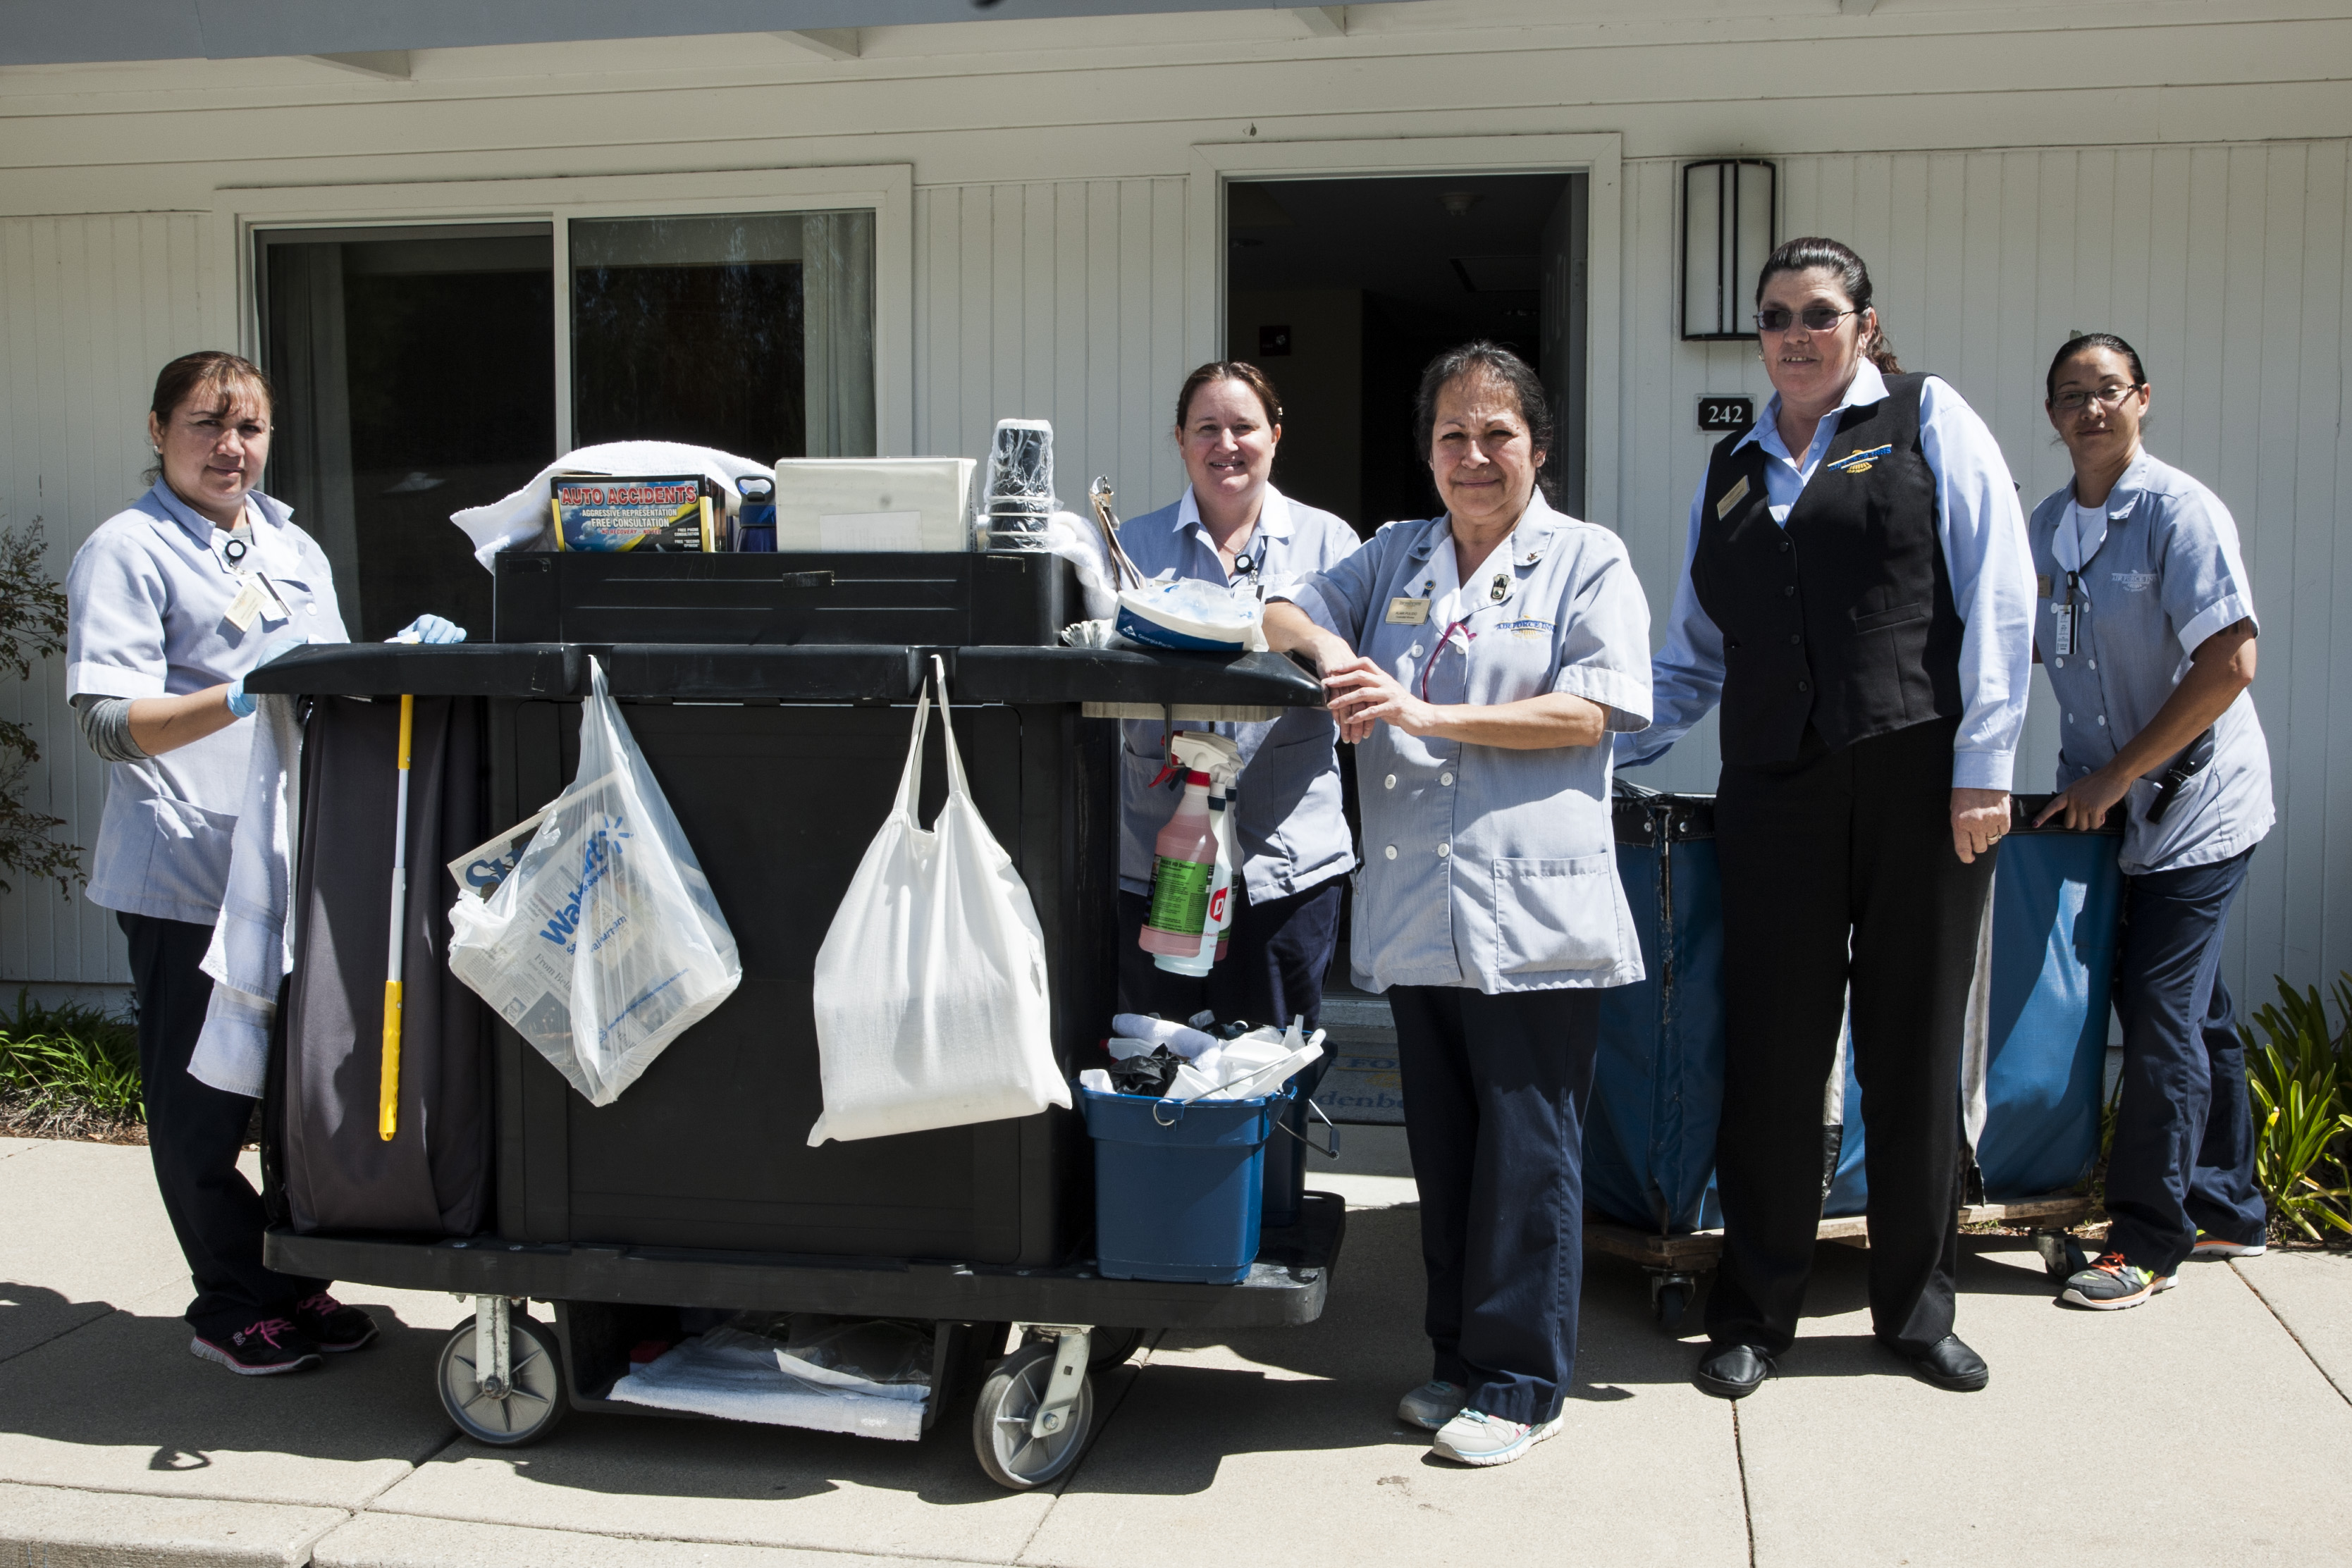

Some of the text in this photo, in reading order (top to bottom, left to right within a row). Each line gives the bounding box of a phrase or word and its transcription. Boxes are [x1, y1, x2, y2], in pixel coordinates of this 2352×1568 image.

[1708, 405, 1743, 423] 242
[561, 485, 697, 505] AUTO ACCIDENTS
[582, 508, 677, 517] AGGRESSIVE REPRESENTATION
[591, 518, 670, 527] FREE CONSULTATION
[1513, 620, 1539, 629] FORCE
[534, 953, 556, 975] From
